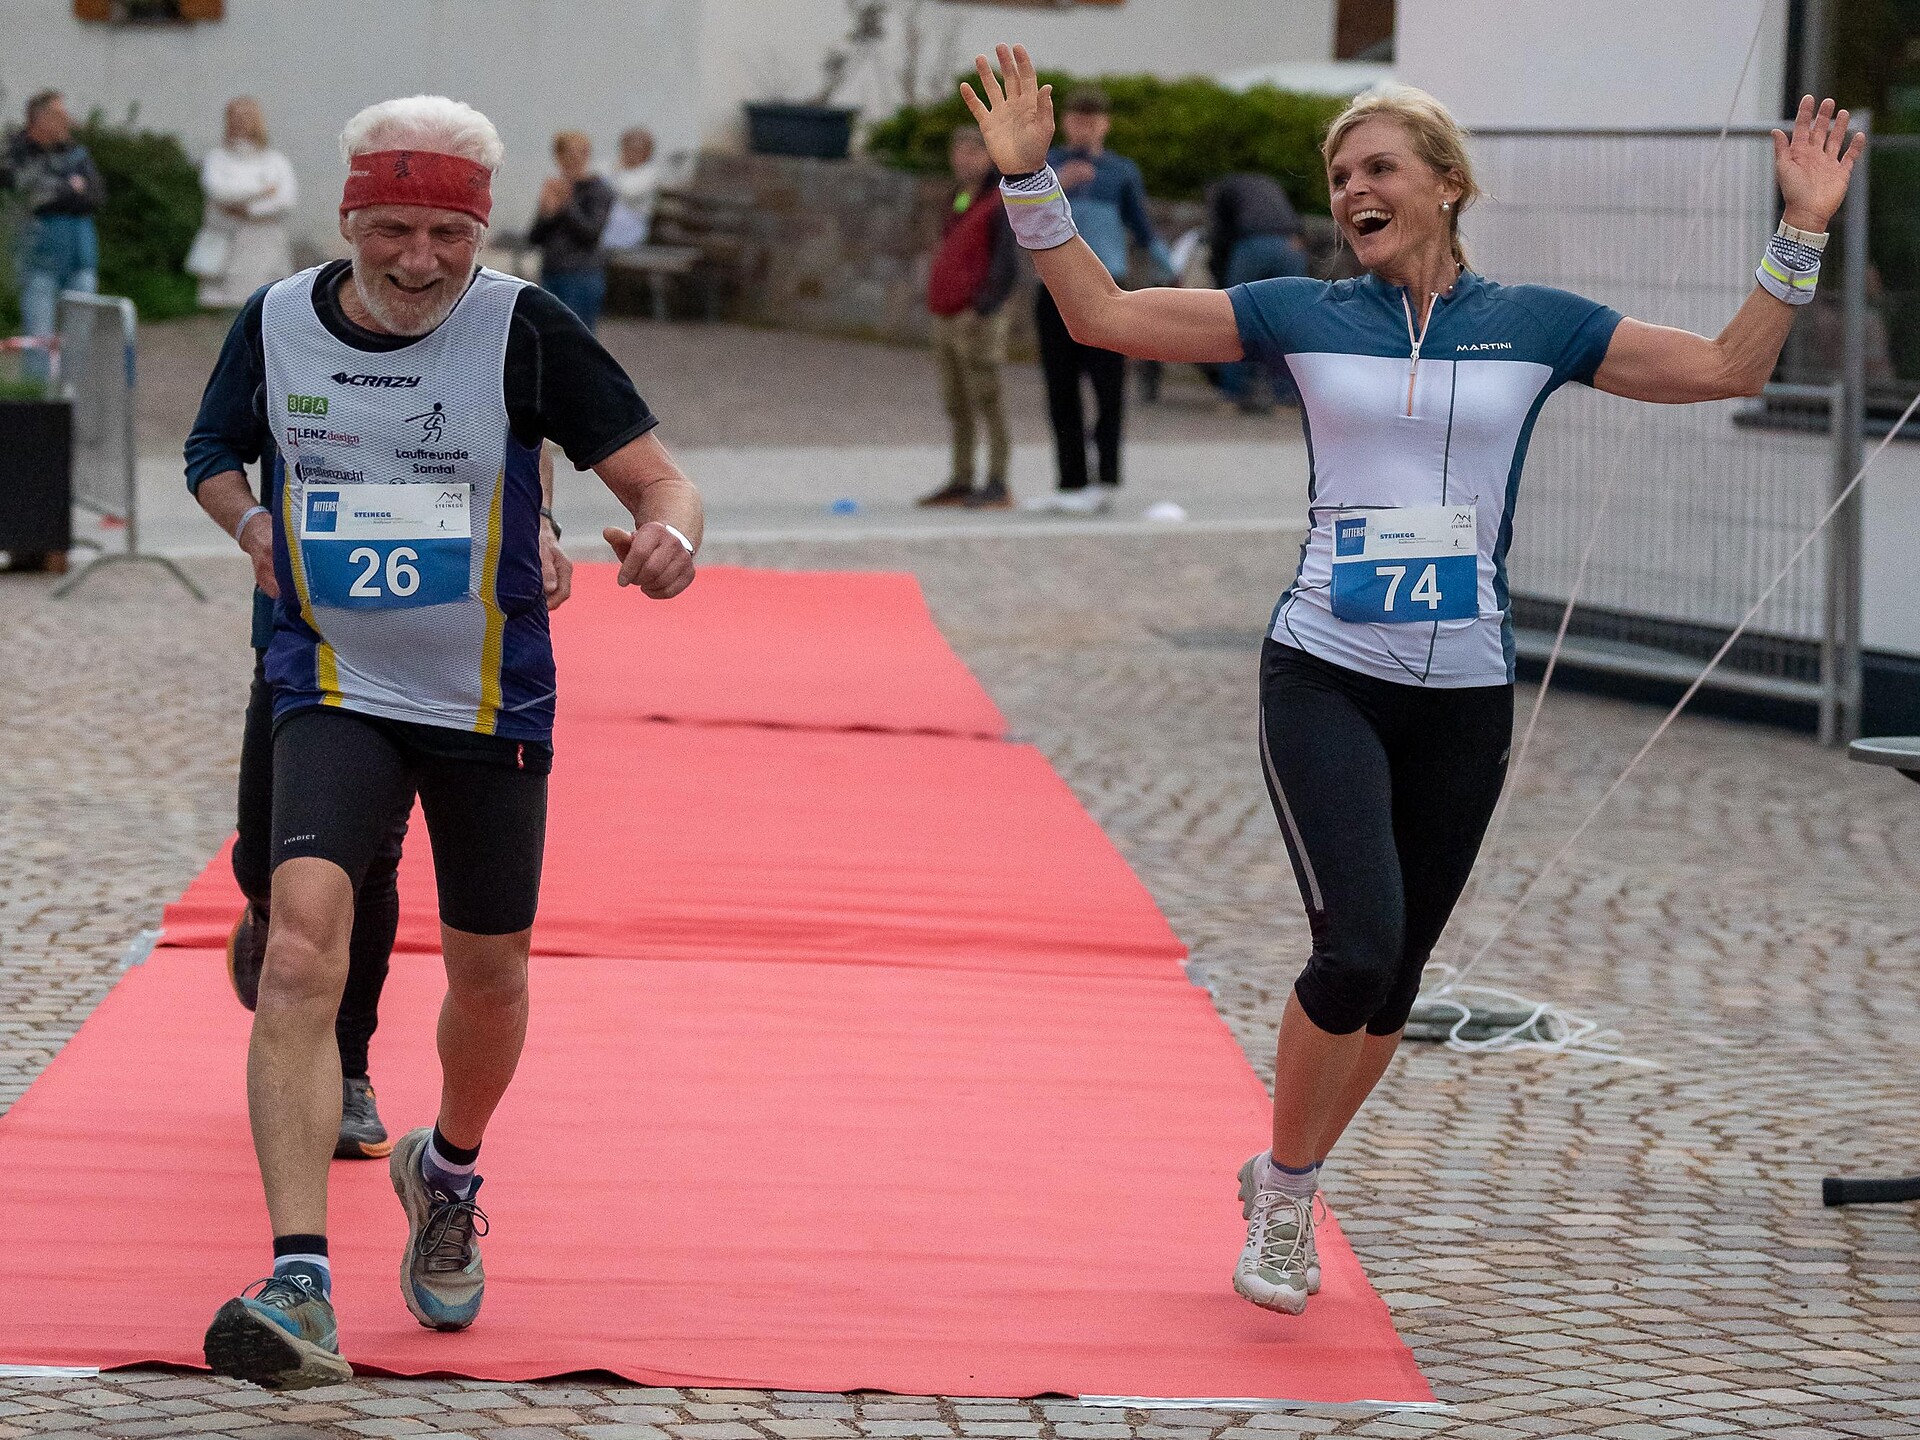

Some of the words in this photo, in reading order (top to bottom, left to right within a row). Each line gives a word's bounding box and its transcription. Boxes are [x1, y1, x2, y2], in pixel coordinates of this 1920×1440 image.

[1456, 342, 1512, 352] MARTINI
[349, 374, 422, 388] CRAZY
[348, 546, 421, 598] 26
[1375, 563, 1443, 612] 74
